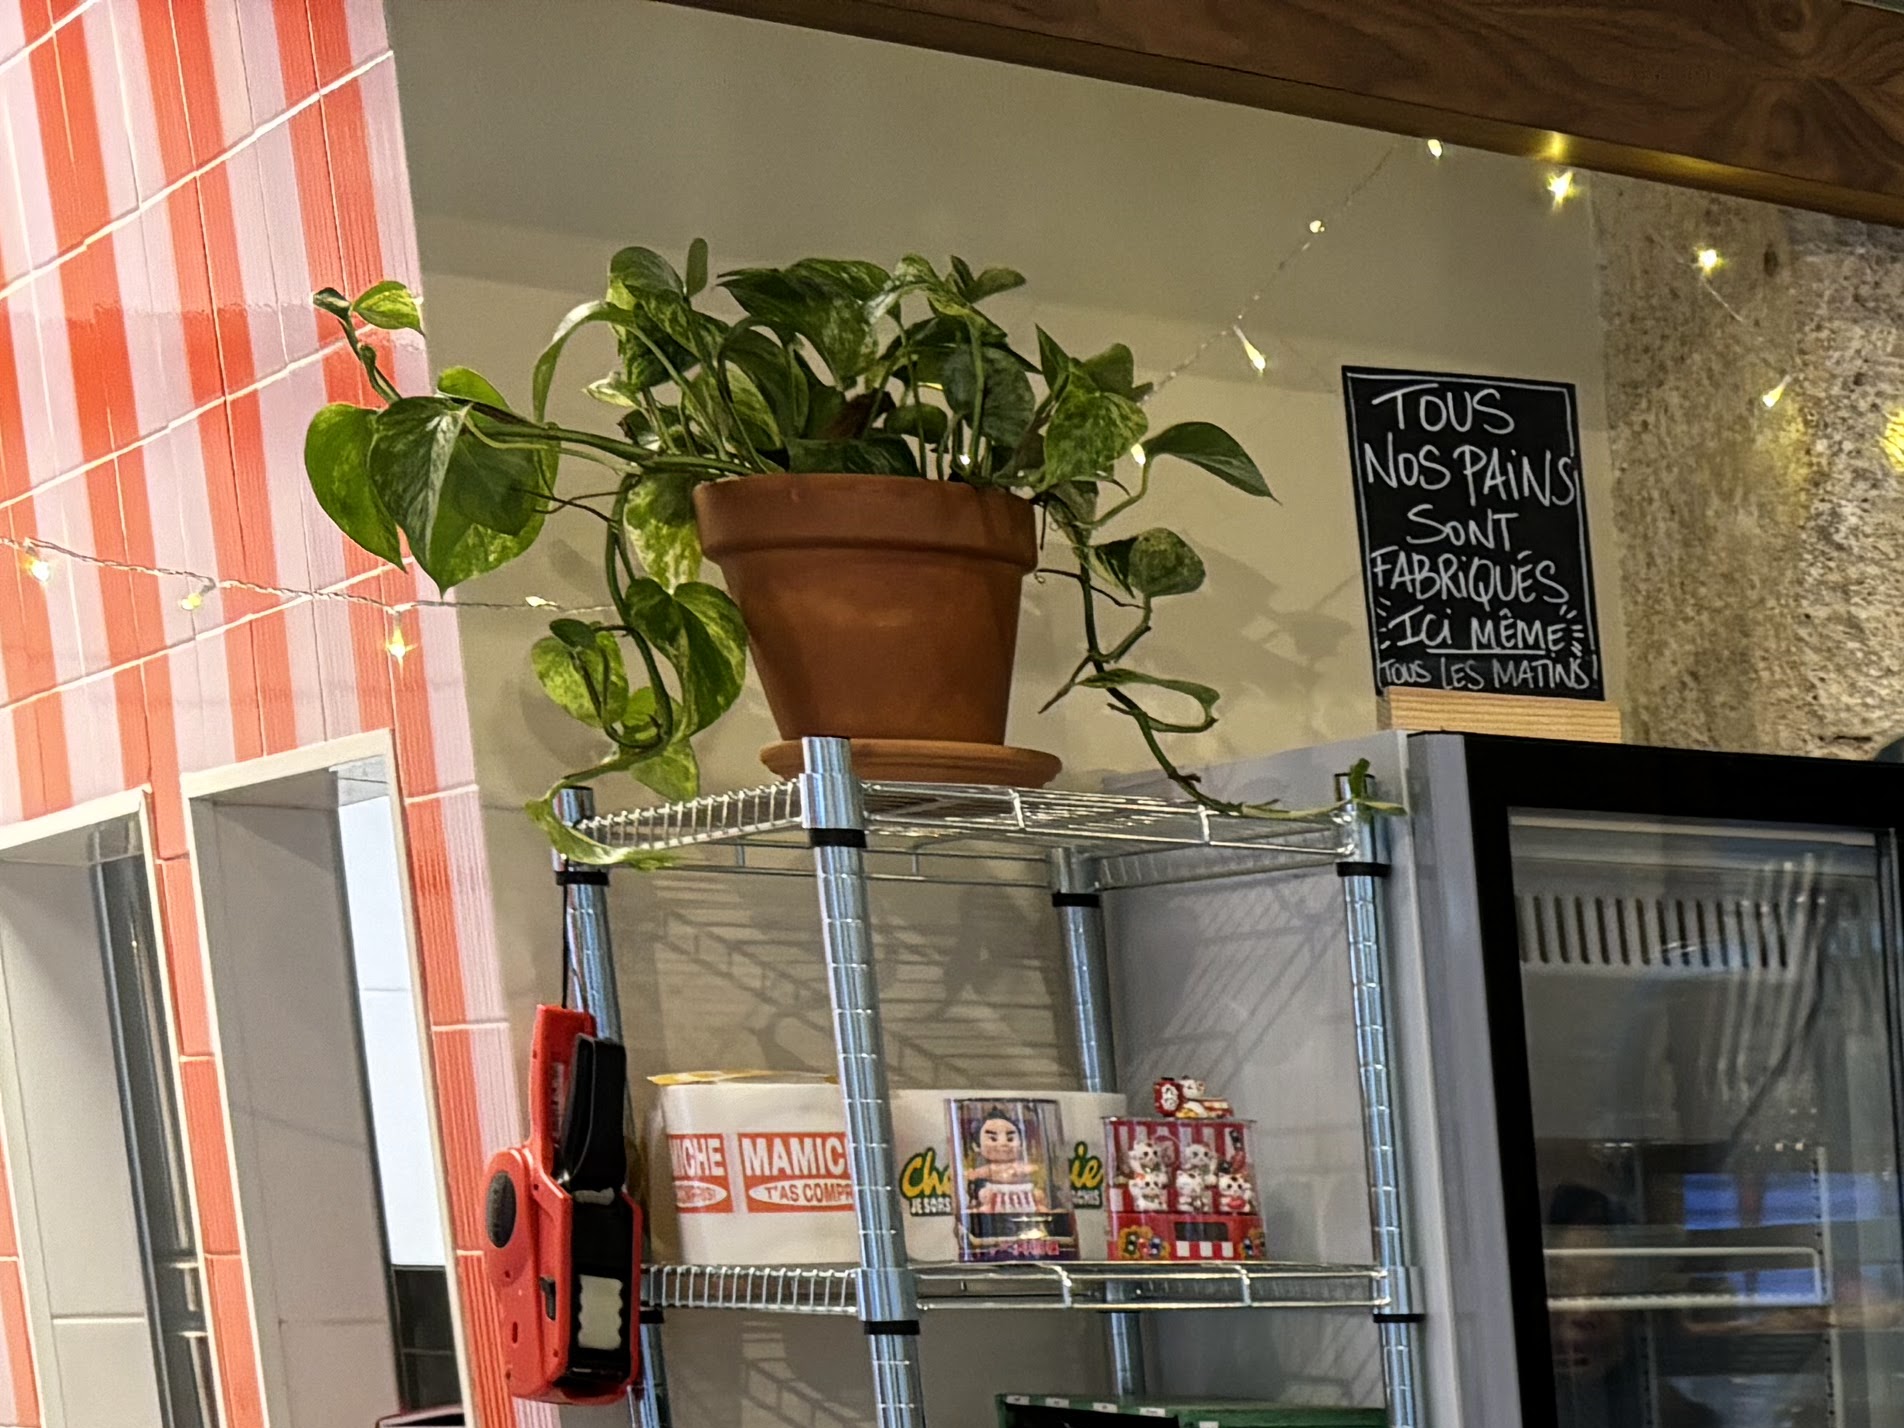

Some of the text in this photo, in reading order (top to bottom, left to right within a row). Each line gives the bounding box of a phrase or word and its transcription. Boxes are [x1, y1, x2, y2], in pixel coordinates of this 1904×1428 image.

[1372, 383, 1514, 434] TOUS
[1364, 433, 1451, 489] NOS
[1406, 504, 1519, 551] SONT
[1471, 608, 1566, 651] MÊME
[1380, 660, 1431, 684] TOUS
[1442, 657, 1485, 690] LES
[741, 1137, 851, 1176] MAMIC
